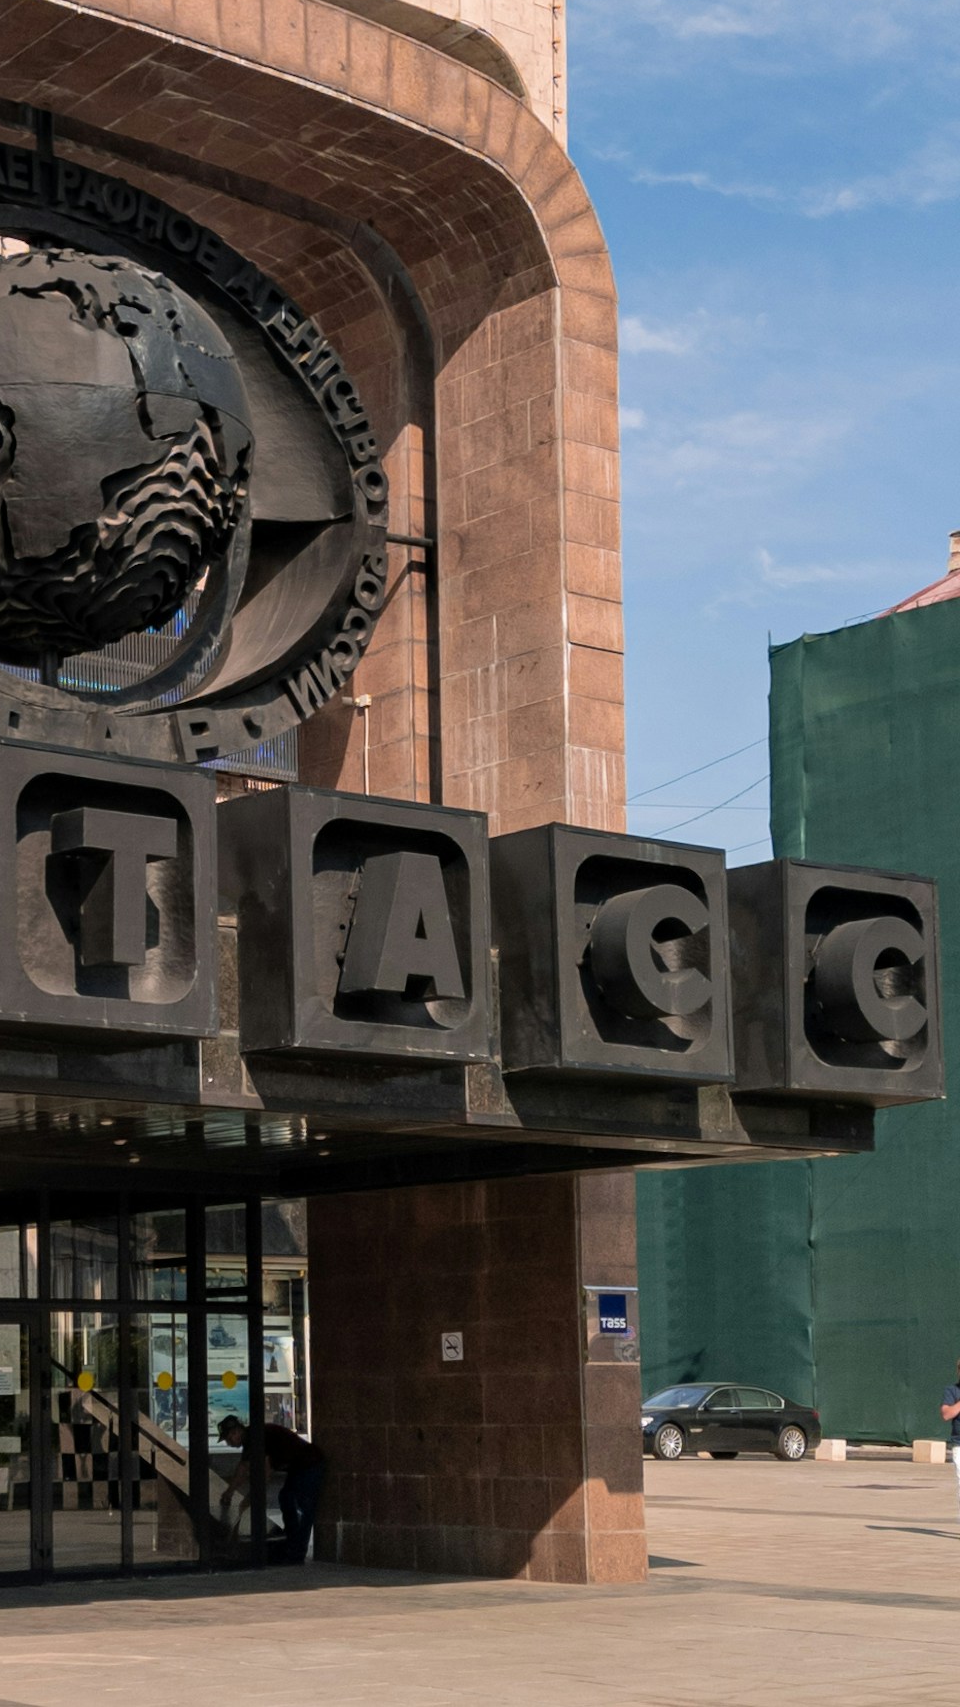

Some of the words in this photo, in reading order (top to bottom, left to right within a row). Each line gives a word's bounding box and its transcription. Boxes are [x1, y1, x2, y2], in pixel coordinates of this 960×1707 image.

[226, 261, 390, 503] АГЕНТСТВО
[286, 551, 388, 721] РОССИИ
[48, 806, 928, 1043] ТАСС
